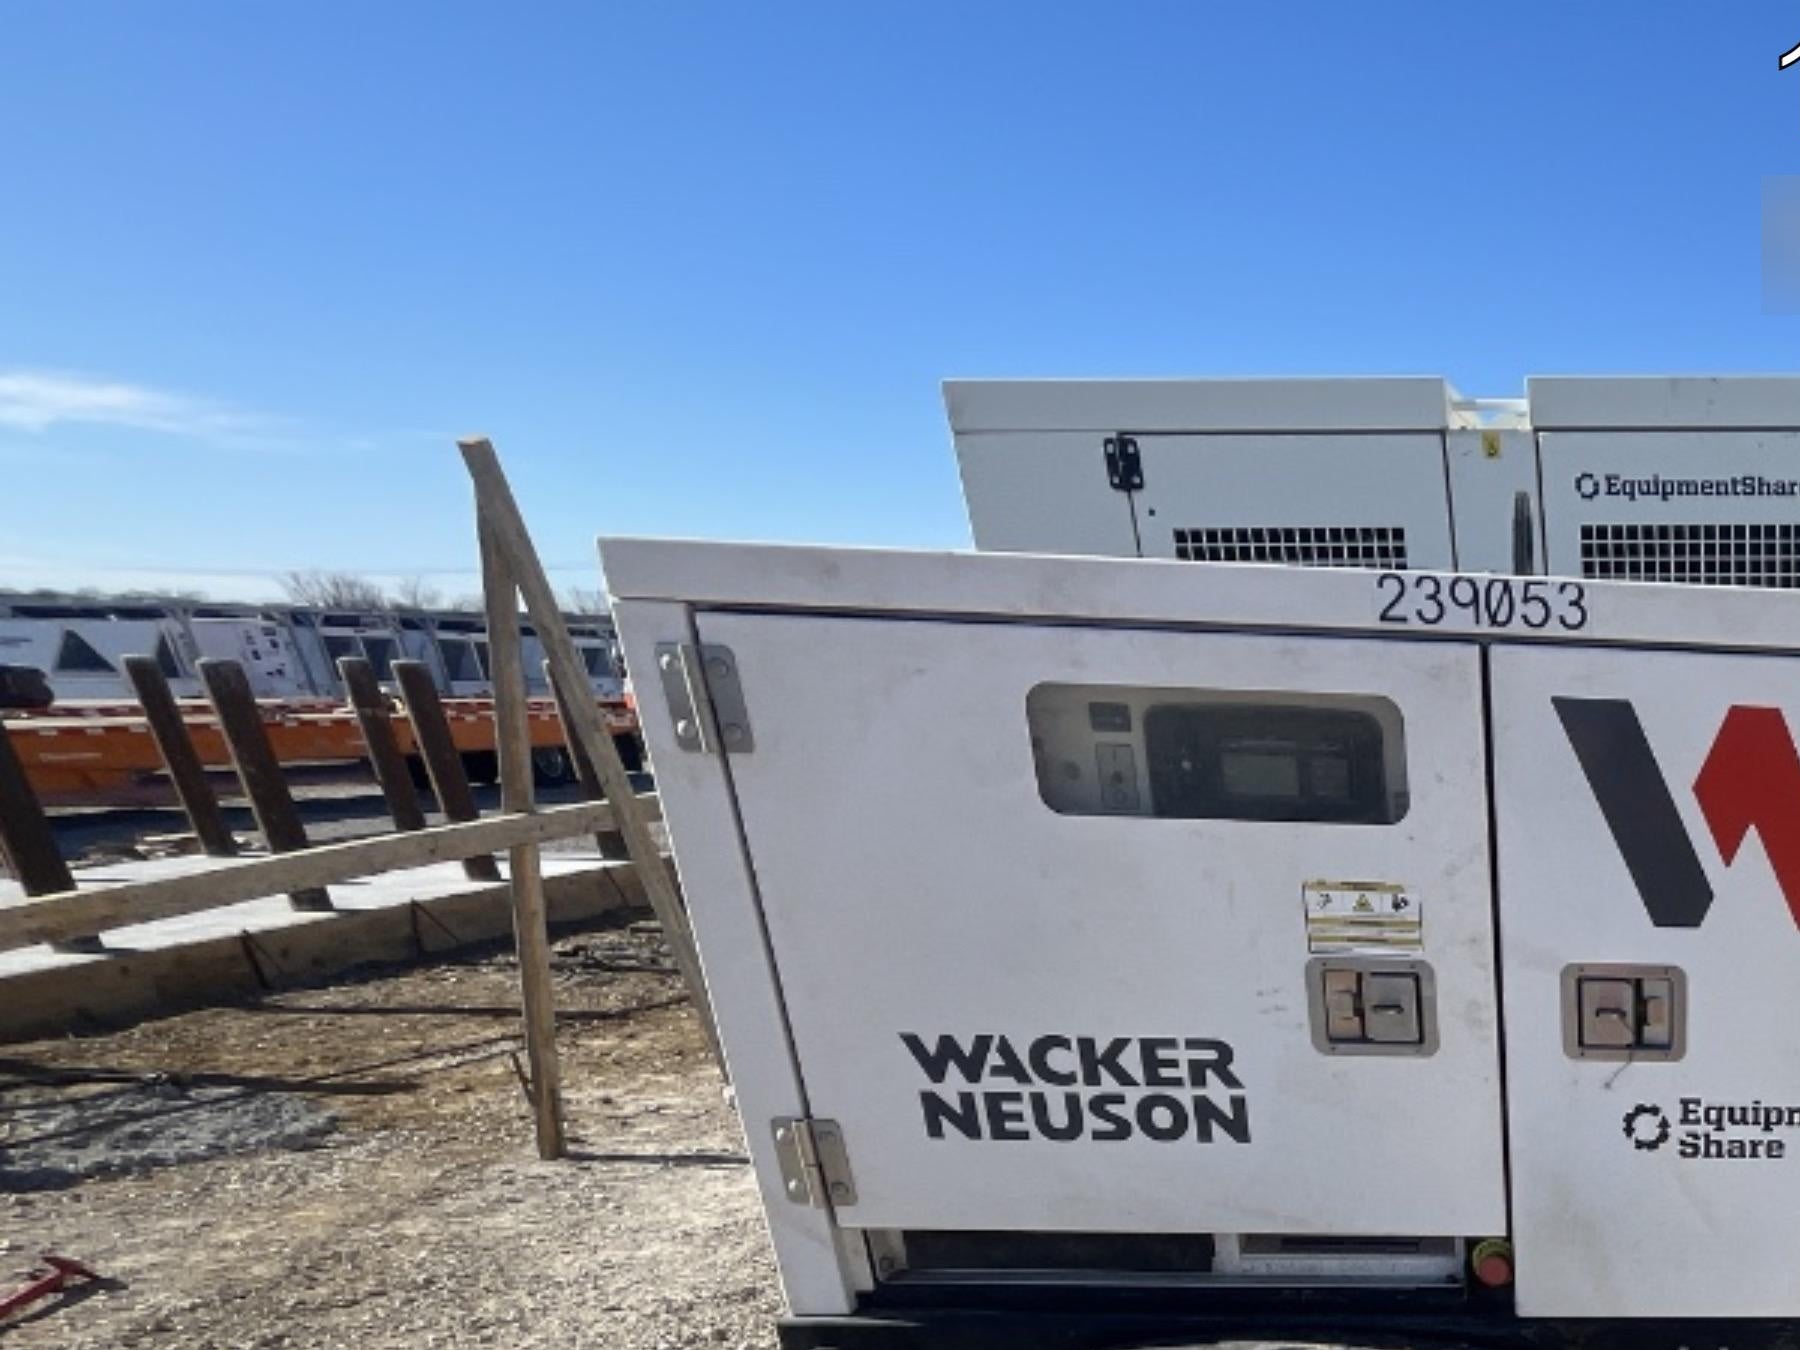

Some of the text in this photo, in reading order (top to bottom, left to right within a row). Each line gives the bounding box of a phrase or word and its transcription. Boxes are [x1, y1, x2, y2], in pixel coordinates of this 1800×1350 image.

[1376, 572, 1590, 631] 239053
[898, 1032, 1245, 1089] WACKER
[919, 1090, 1252, 1144] NEUSON
[1678, 1133, 1786, 1159] Share
